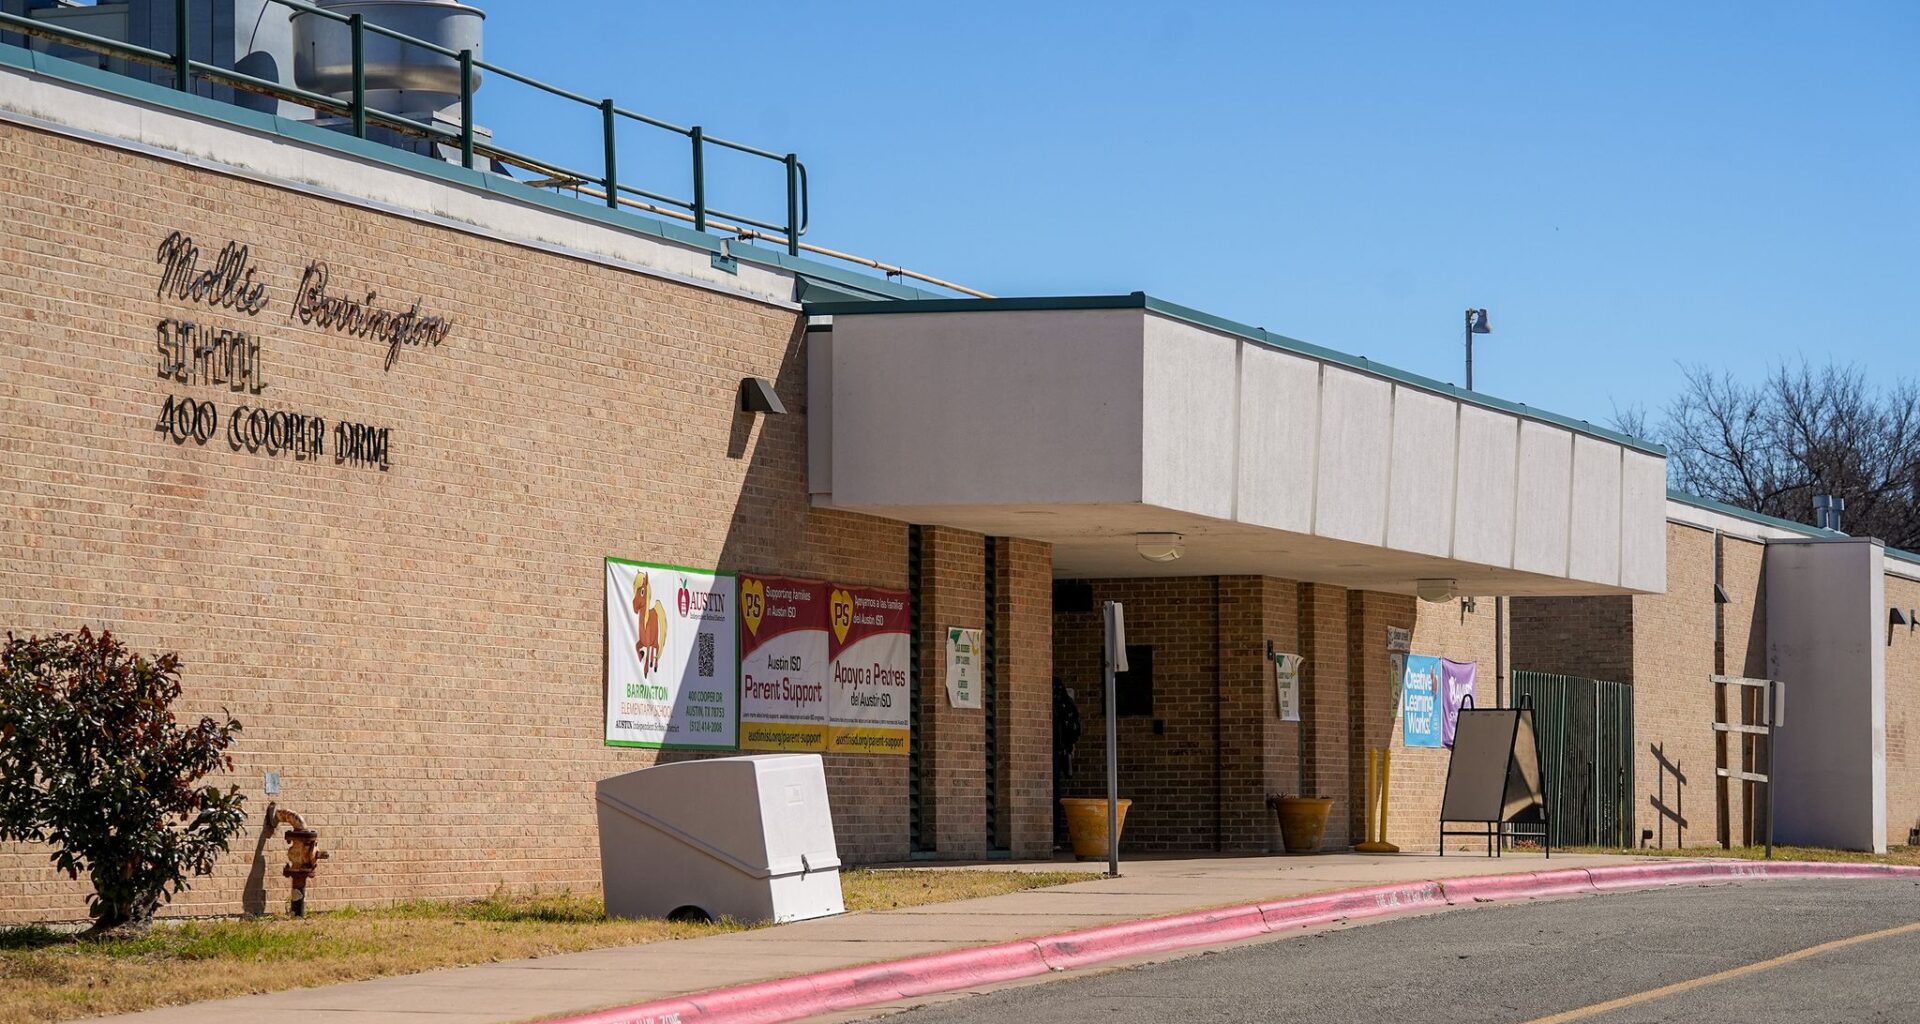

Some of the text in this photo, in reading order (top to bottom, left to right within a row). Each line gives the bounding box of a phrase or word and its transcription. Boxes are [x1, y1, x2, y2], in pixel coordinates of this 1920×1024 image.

[157, 231, 454, 372] Mollie Barrington
[157, 318, 267, 394] SCHOOL
[156, 395, 393, 468] 400 COOPER DRIVE
[690, 592, 725, 612] AUSTIN
[766, 585, 811, 602] Supporting families
[745, 593, 760, 618] PS
[767, 605, 797, 618] in Austin ISD
[834, 602, 849, 626] PS
[853, 613, 884, 626] del Austin ISD
[768, 654, 801, 671] Austin ISD
[834, 660, 906, 690] Apoyo a Padres
[1406, 666, 1432, 691] Creative
[626, 683, 668, 701] BARRINGTON
[697, 691, 715, 702] COOPER
[745, 675, 822, 708] Parent Support
[850, 692, 891, 708] del Austin ISD
[621, 702, 654, 716] ELEMENTARY
[704, 706, 711, 717] TX
[1405, 689, 1434, 717] Learning
[615, 720, 632, 729] AUSTIN
[1408, 712, 1431, 734] Works!
